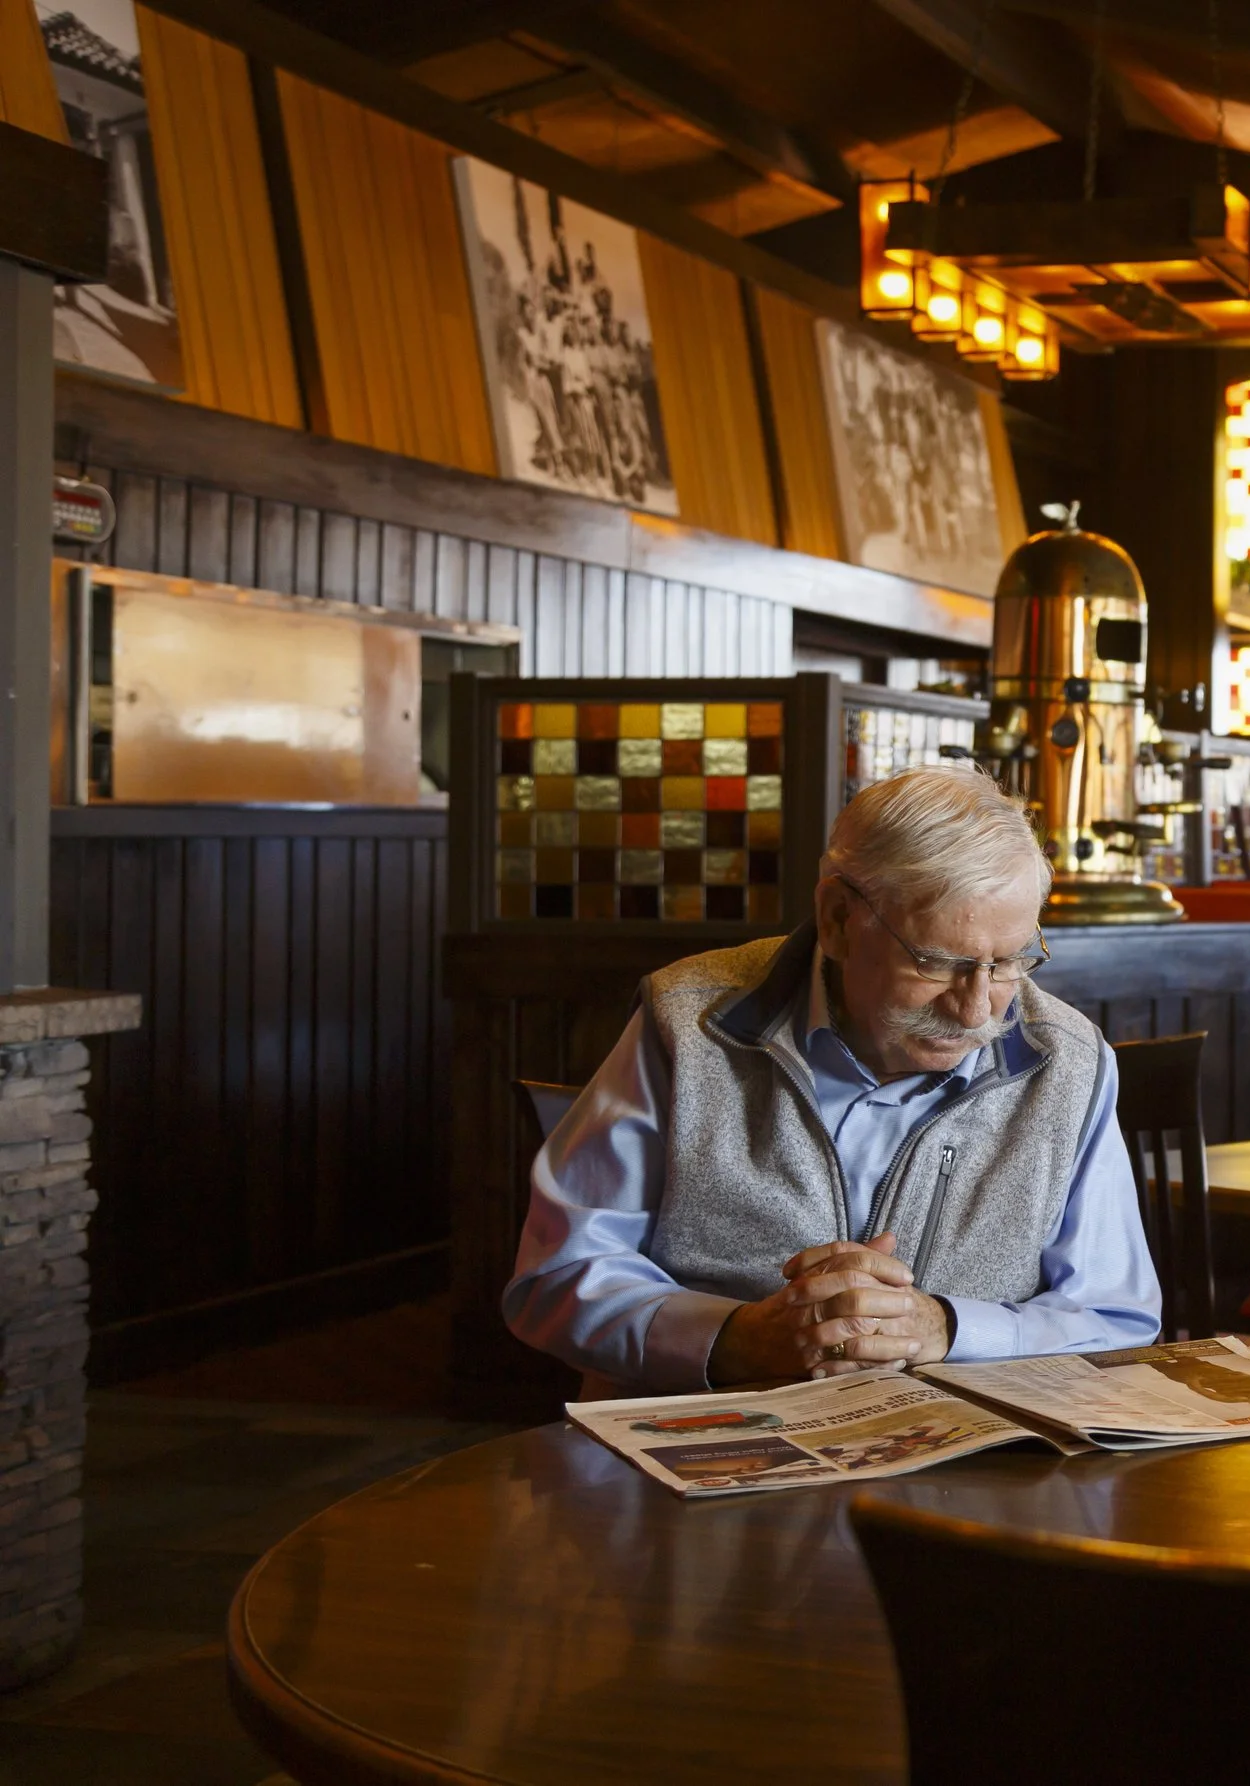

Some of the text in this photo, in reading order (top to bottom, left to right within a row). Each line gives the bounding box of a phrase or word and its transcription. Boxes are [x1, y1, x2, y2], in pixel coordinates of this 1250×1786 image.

[891, 1396, 925, 1409] STOP
[831, 1407, 888, 1425] CLIMATE
[771, 1422, 826, 1433] CHANGE
